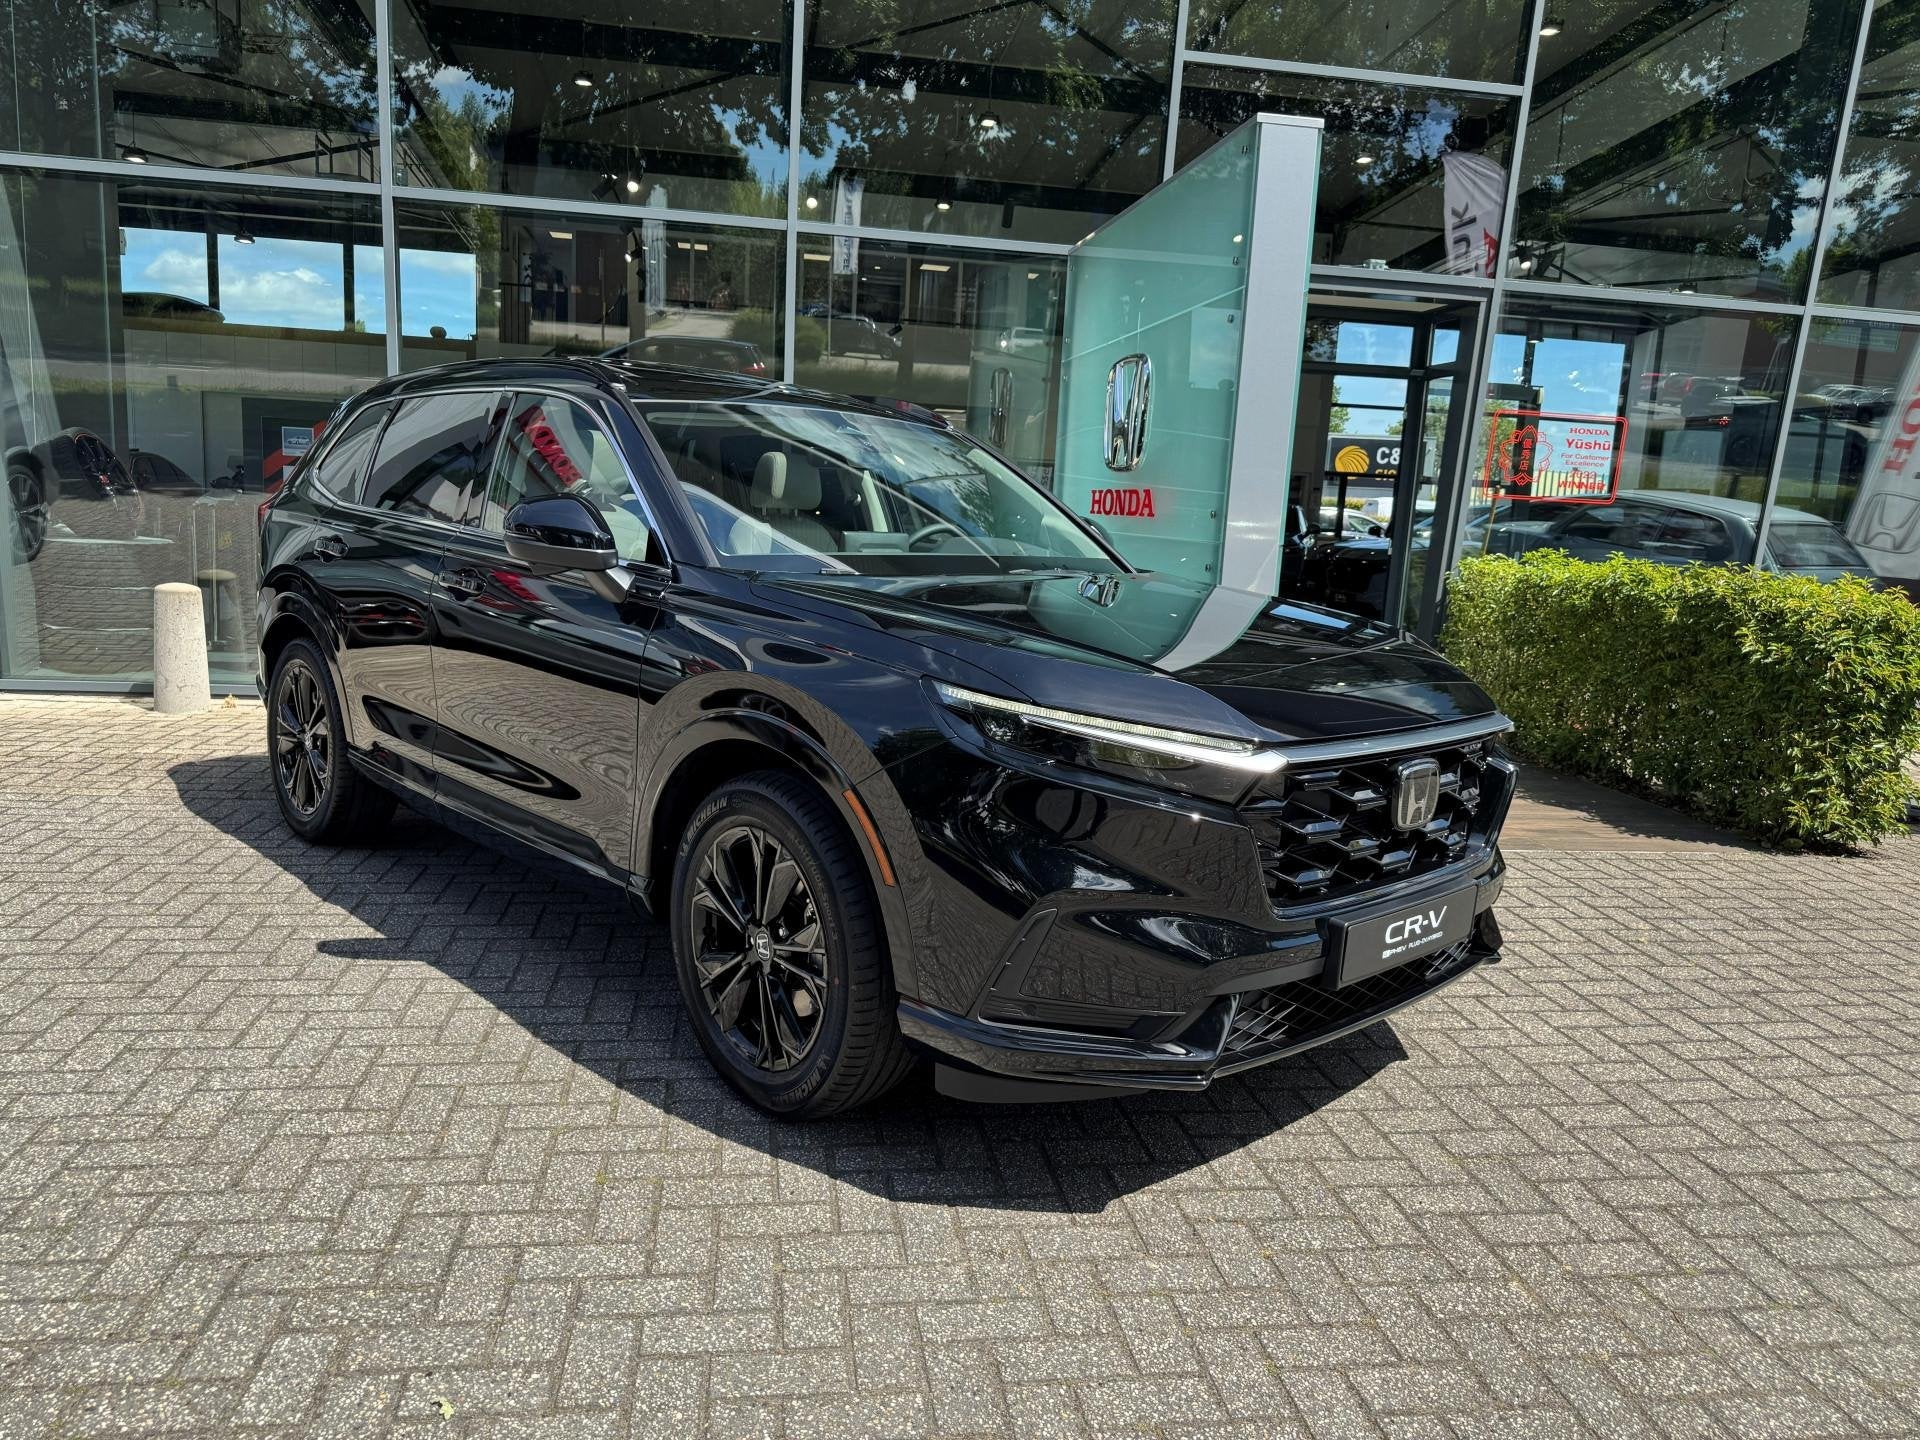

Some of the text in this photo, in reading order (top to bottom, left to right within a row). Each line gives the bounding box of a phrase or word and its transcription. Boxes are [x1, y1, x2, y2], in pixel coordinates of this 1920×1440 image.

[1569, 427, 1610, 437] HONDA
[1565, 438, 1611, 451] Yūshū
[1560, 452, 1610, 462] For Customer
[1565, 460, 1605, 468] Excellence
[1557, 480, 1606, 491] WINNER
[1089, 488, 1155, 517] HONDA
[687, 796, 728, 841] MICHELIN
[1385, 905, 1447, 944] CR-V
